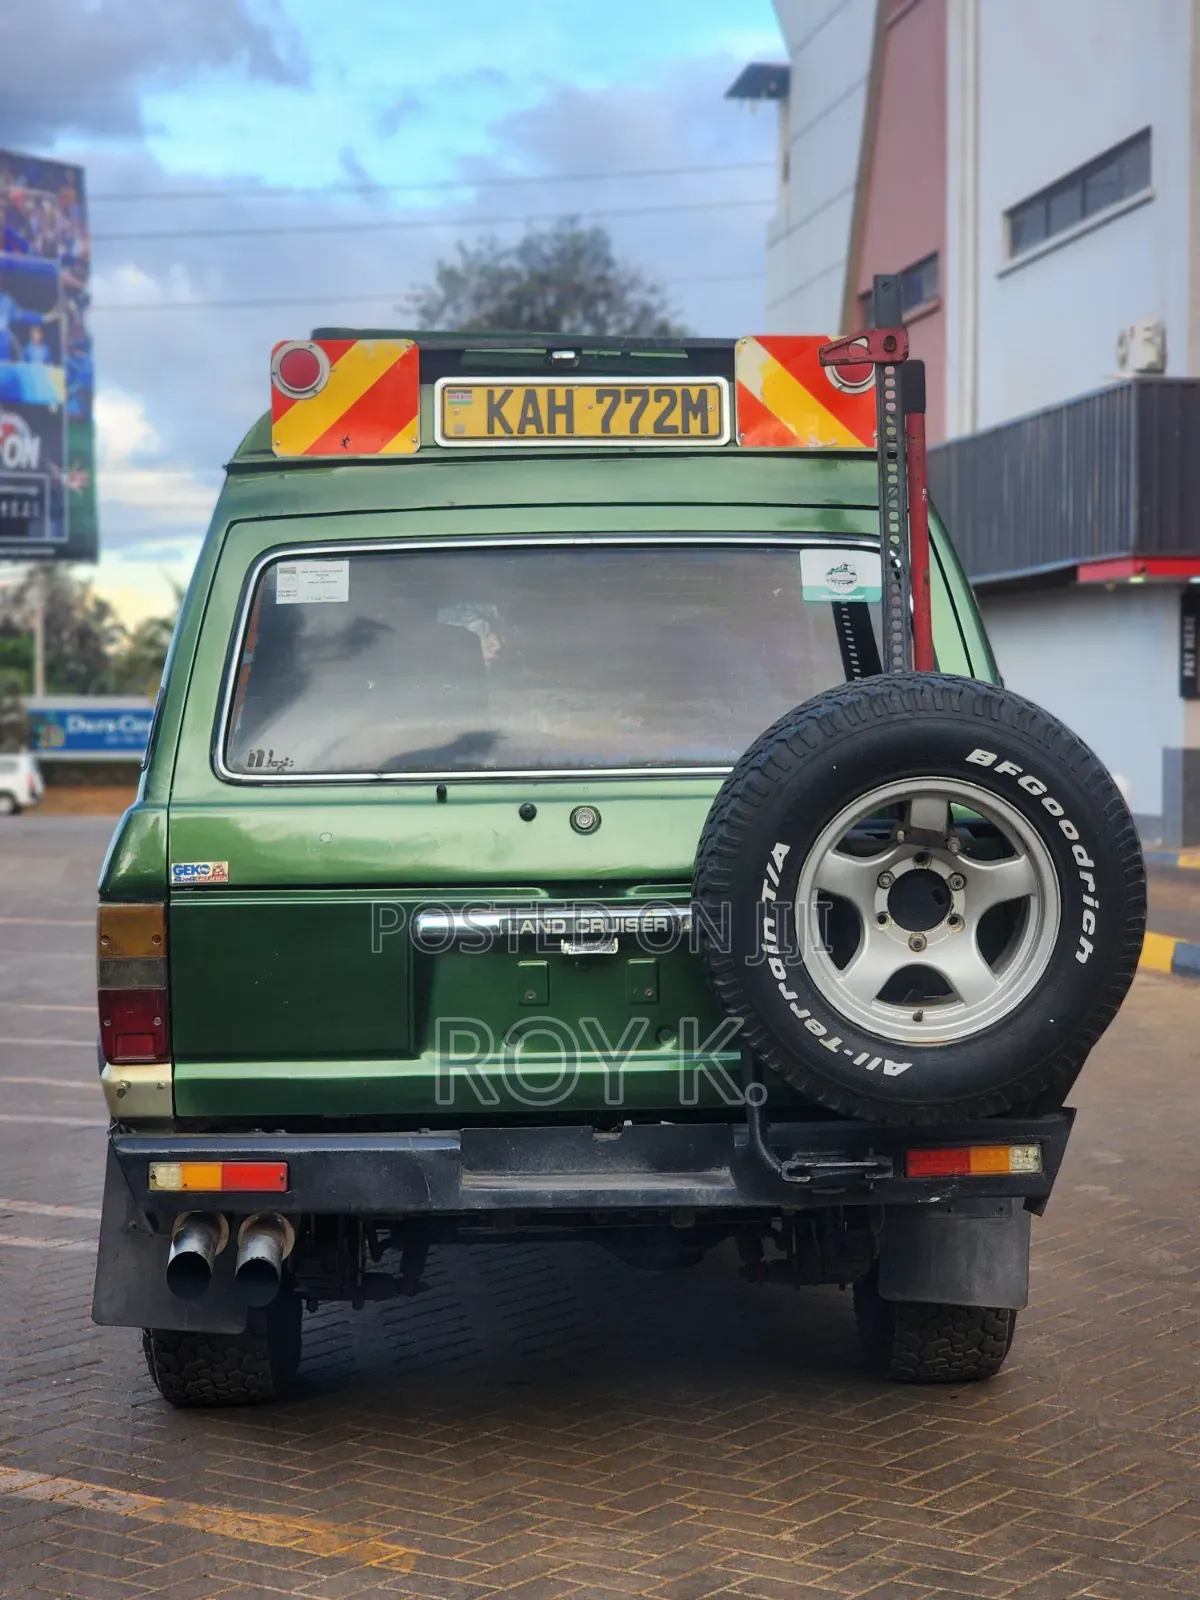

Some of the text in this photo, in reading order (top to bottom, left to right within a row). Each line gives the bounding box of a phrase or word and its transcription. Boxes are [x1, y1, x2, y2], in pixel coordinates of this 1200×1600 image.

[486, 388, 710, 435] KAH 772M
[761, 841, 792, 903] T/A
[964, 747, 1101, 965] BFGoodrich
[510, 916, 669, 935] LAND CRUISER
